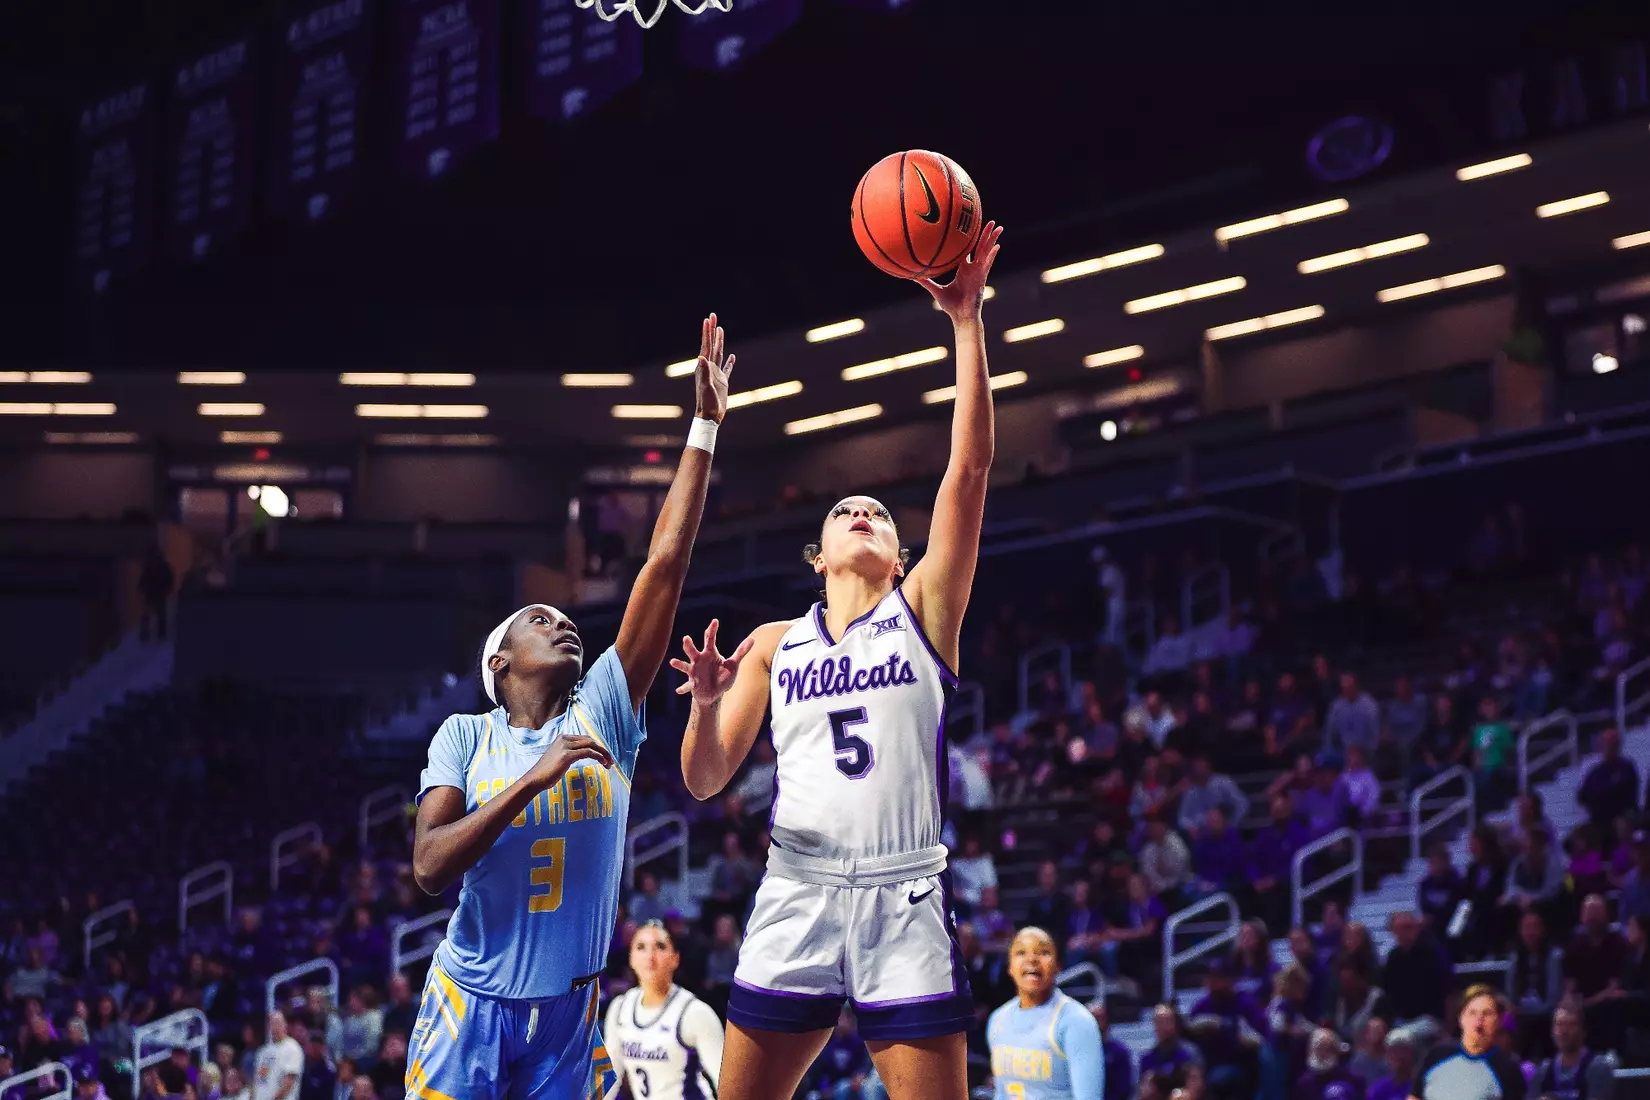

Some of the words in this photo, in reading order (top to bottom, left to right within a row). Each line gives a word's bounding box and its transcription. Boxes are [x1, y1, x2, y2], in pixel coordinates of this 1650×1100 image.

[872, 613, 905, 639] XII
[778, 651, 918, 706] Wildcats
[827, 706, 875, 780] 5
[476, 766, 613, 828] SHERN
[528, 837, 566, 913] 3
[636, 1068, 649, 1098] 3
